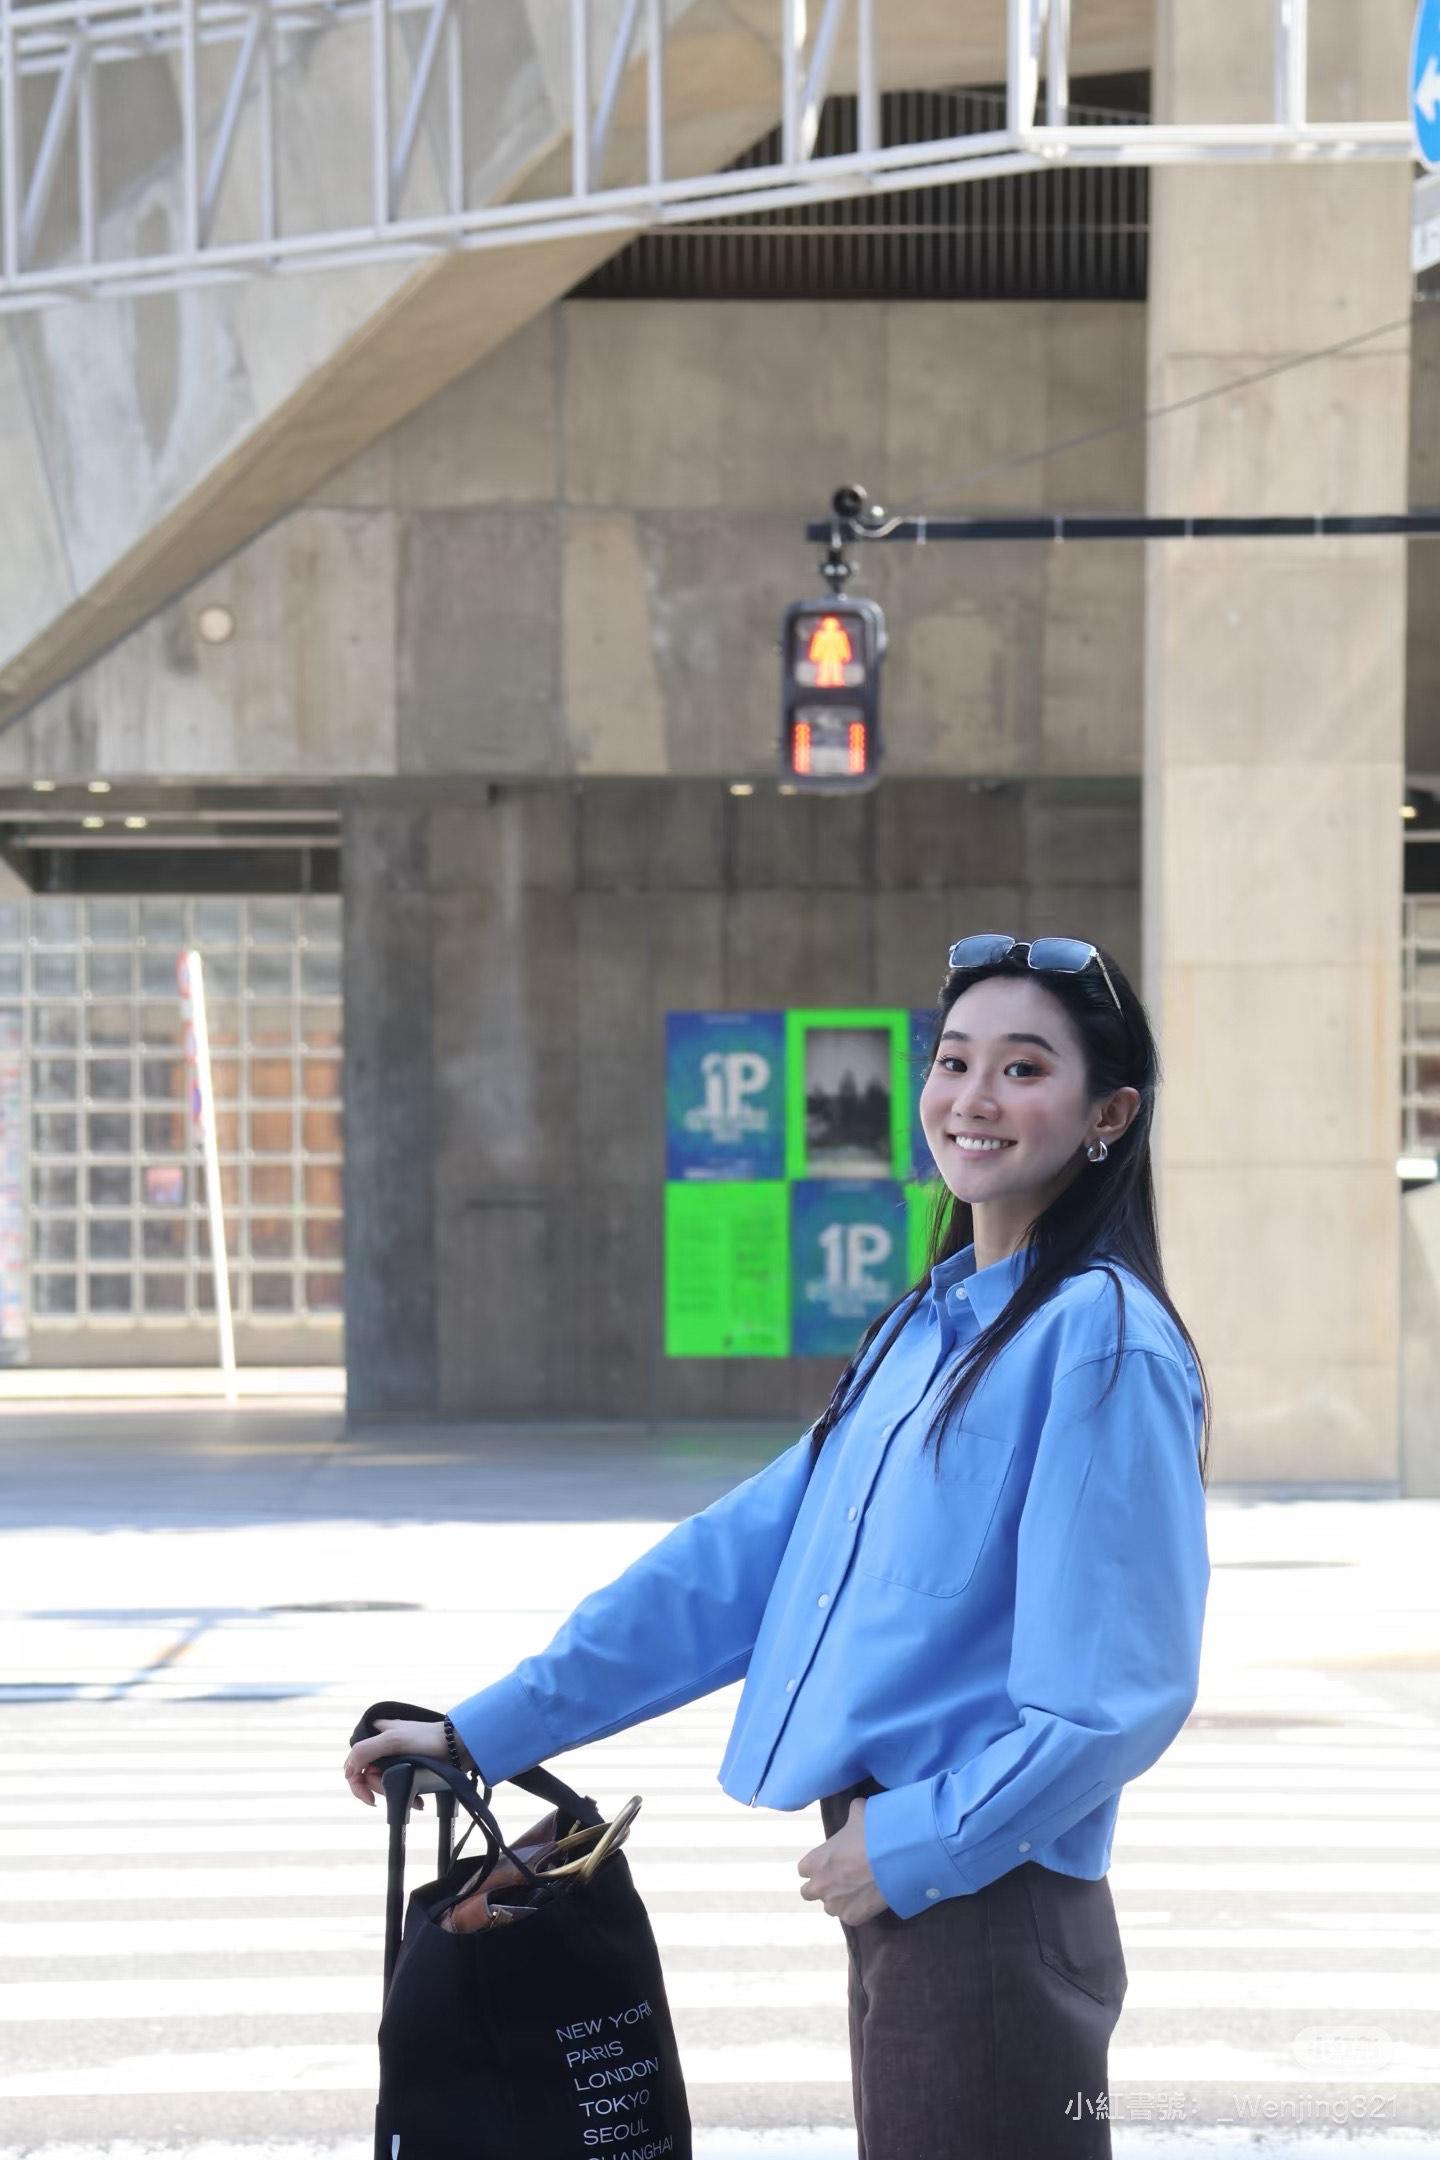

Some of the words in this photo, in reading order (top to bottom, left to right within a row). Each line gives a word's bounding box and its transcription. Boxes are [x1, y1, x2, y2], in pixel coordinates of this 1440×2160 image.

[555, 2017, 603, 2043] NEW
[565, 2040, 625, 2069] PARIS
[573, 2056, 659, 2092] LONDON
[578, 2088, 651, 2118] TOKYO
[583, 2118, 650, 2146] SEOUL
[587, 2134, 673, 2160] ANGHAI
